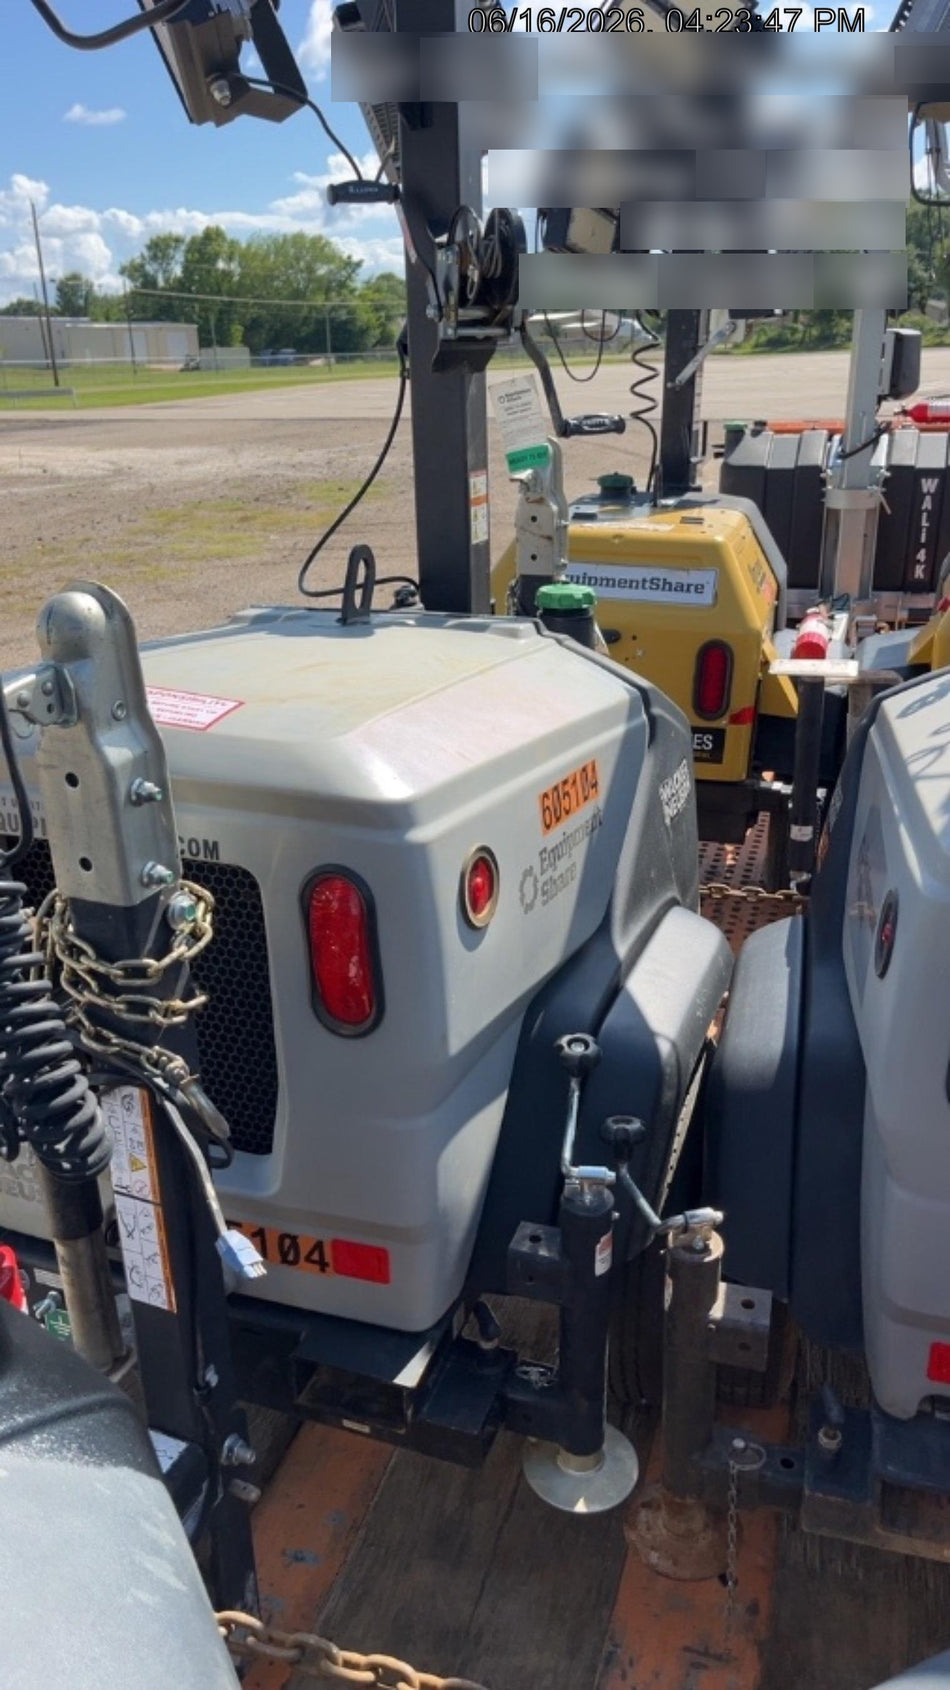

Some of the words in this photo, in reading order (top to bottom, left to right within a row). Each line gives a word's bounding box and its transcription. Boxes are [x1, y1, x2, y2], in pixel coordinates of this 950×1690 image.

[541, 760, 598, 830] 605104
[539, 806, 603, 876] Equipment
[540, 862, 577, 906] Share
